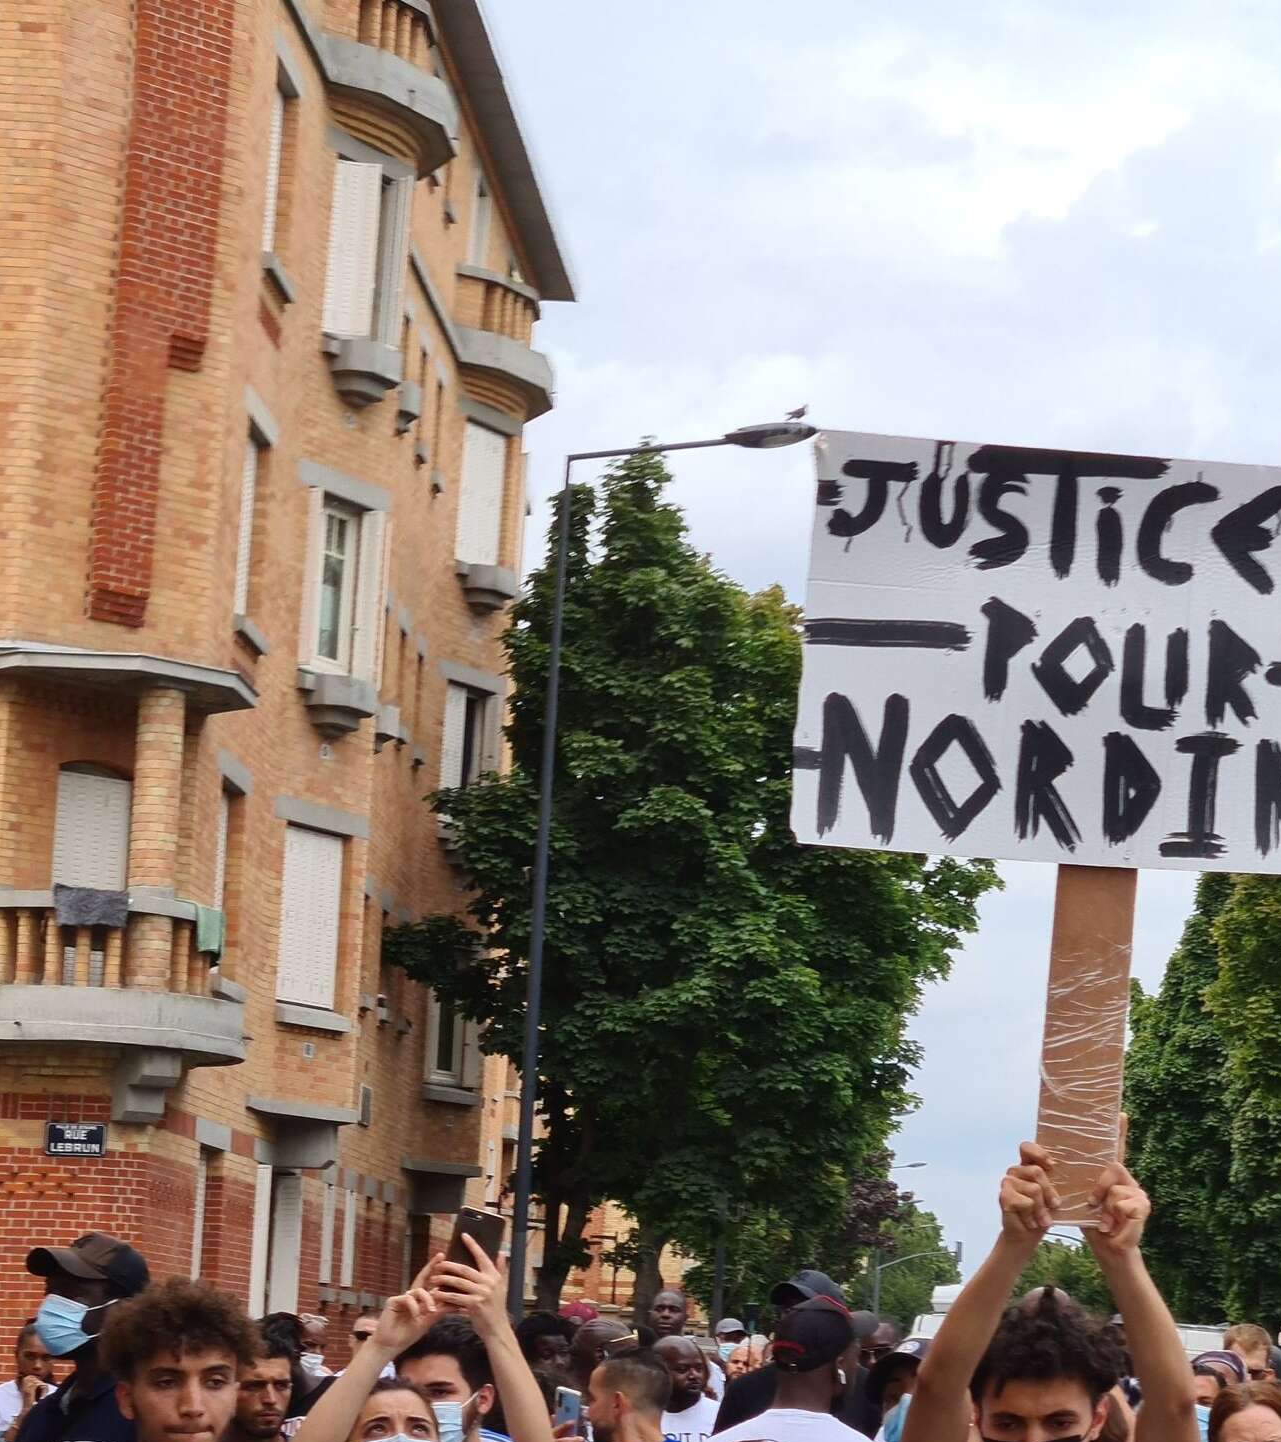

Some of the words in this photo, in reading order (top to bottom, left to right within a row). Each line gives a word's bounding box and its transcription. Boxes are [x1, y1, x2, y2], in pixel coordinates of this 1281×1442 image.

[981, 596, 1263, 730] POUR
[63, 1129, 88, 1140] RUE
[49, 1142, 100, 1153] LEBRUN
